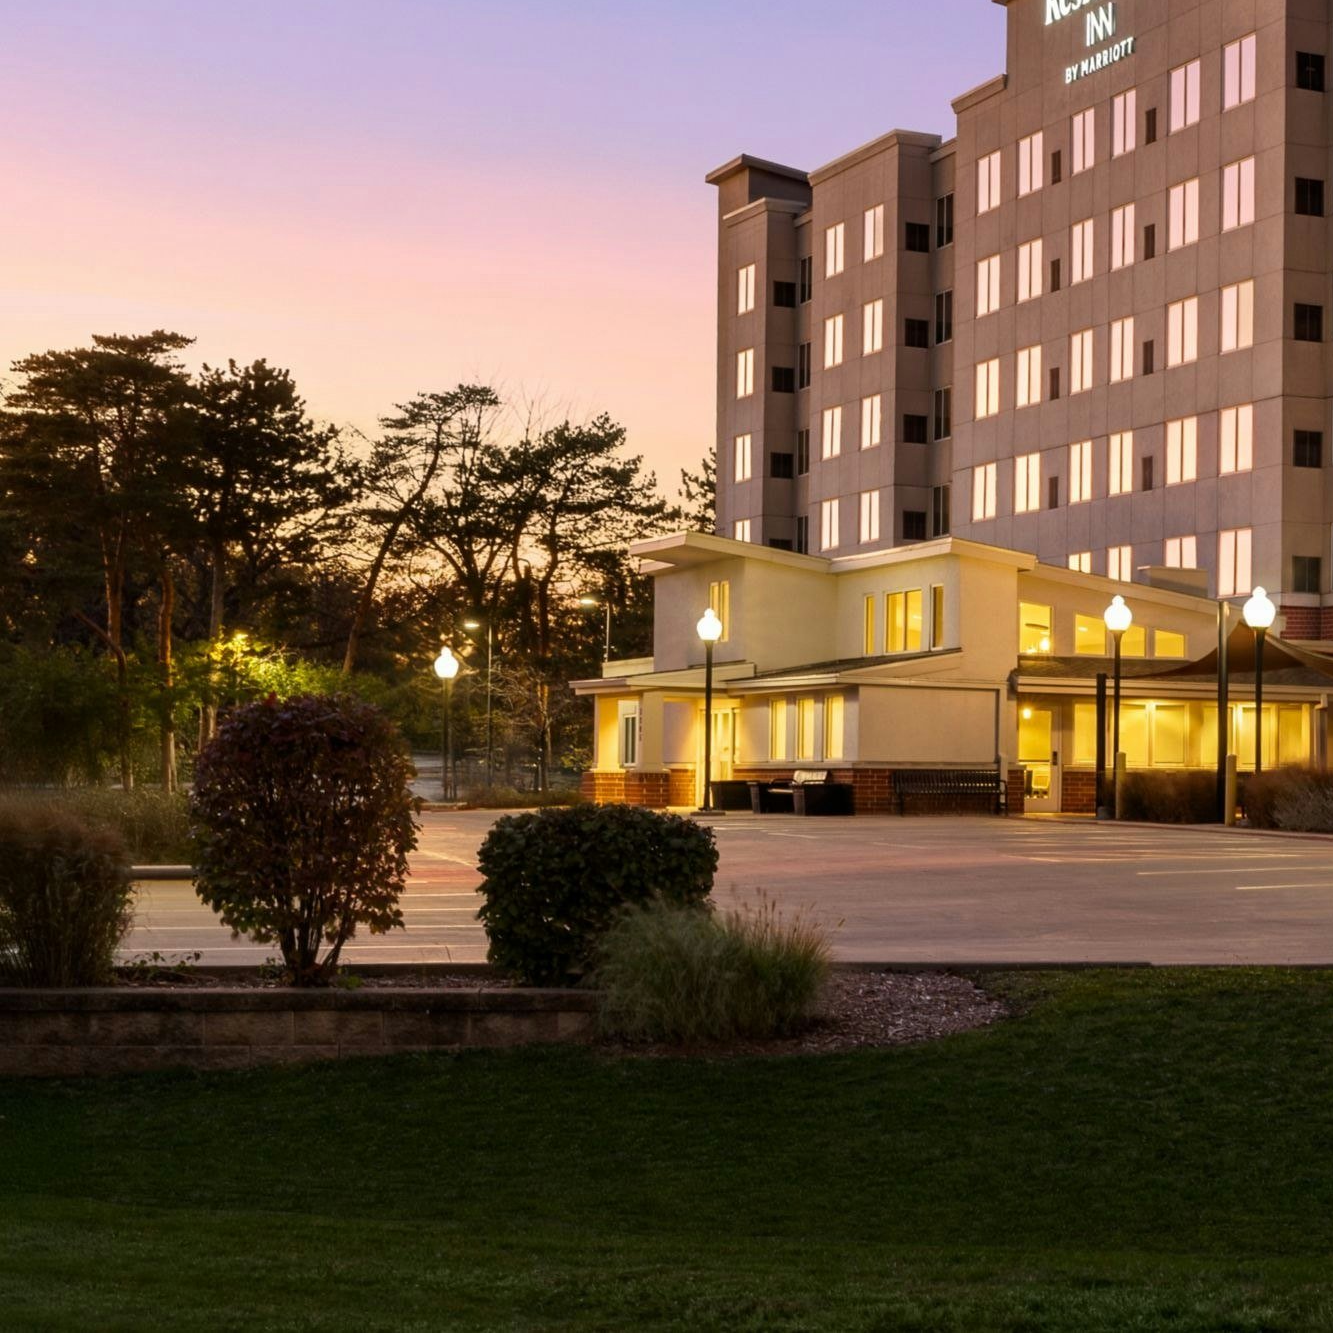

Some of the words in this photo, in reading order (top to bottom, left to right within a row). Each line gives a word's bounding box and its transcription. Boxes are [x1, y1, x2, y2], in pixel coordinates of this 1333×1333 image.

[1086, 1, 1114, 48] INN
[1064, 63, 1079, 84] BY
[1080, 36, 1135, 78] MARRIOTT
